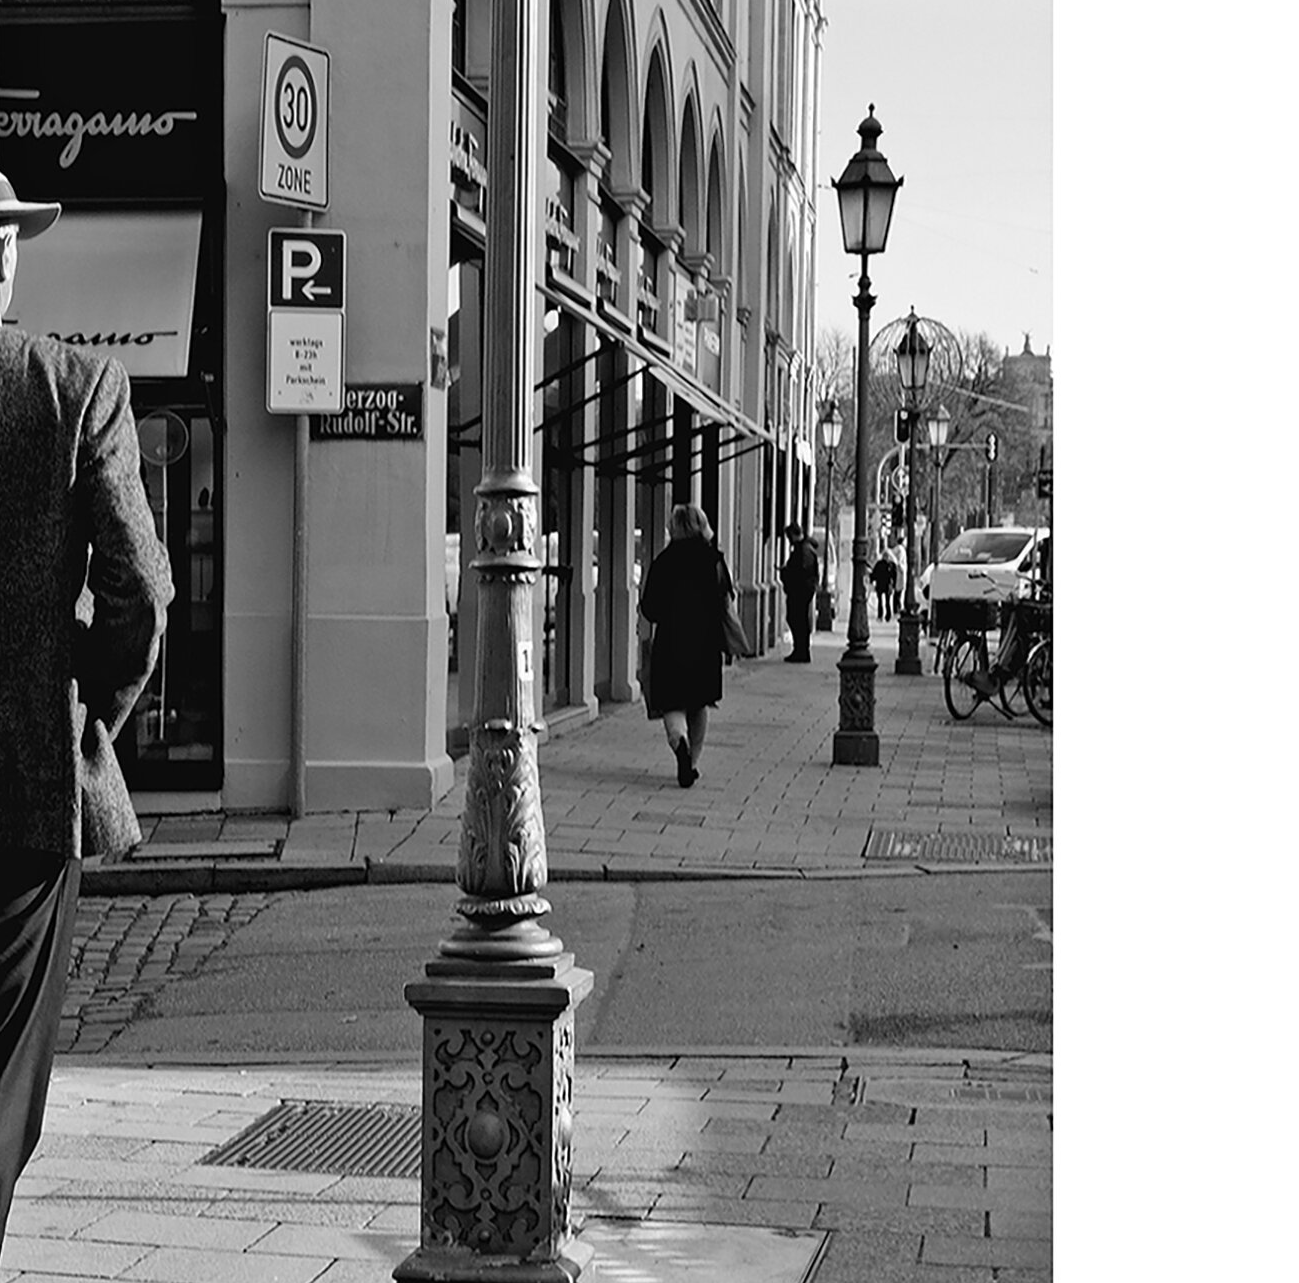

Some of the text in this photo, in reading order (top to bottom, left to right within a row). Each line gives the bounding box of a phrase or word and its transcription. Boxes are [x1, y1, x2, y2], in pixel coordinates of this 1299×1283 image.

[282, 82, 308, 133] 30
[277, 163, 312, 195] ZONE
[282, 240, 322, 300] P
[346, 390, 404, 411] erzog-
[320, 410, 418, 435] Rudolf-Str.
